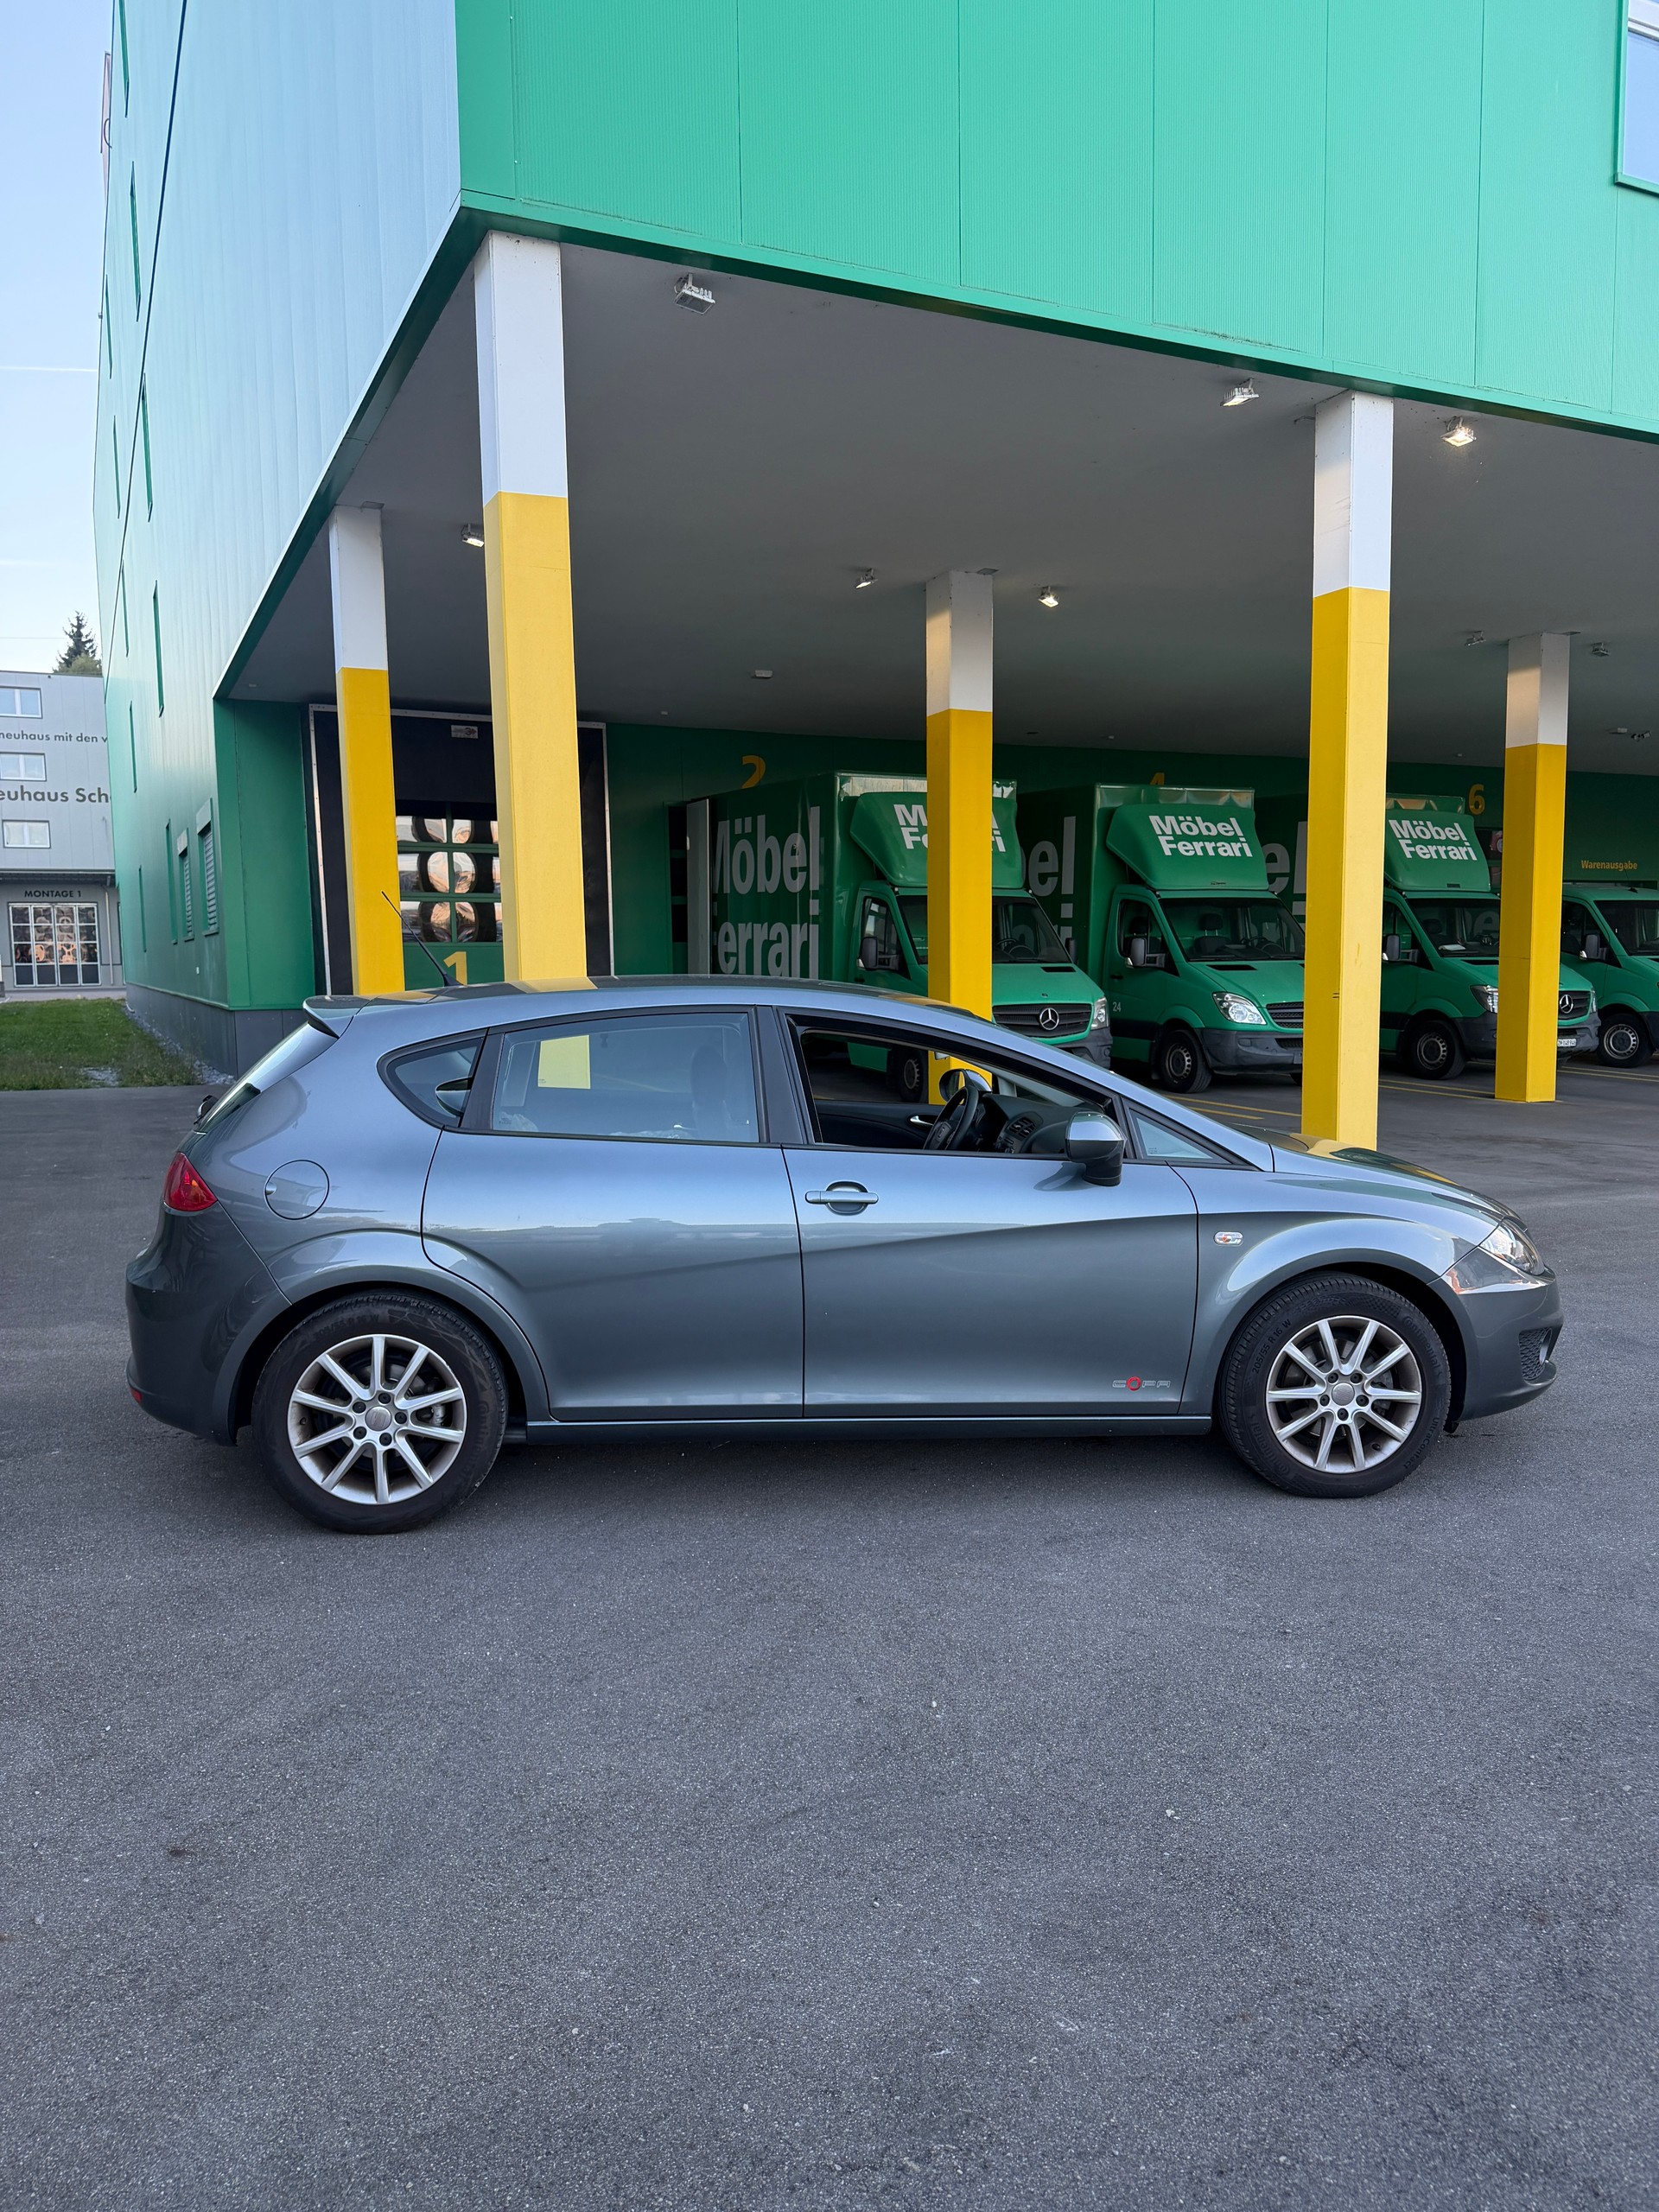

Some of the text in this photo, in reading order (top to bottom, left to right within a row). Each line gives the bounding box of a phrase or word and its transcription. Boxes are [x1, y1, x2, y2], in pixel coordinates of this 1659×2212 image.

[54, 732, 73, 742] mit
[76, 733, 98, 742] den
[741, 755, 766, 789] 2
[75, 787, 111, 803] Sch
[1468, 784, 1485, 815] 6
[1148, 815, 1244, 837] Möbel
[1388, 819, 1468, 842] Möbel
[1157, 836, 1253, 857] Ferrari
[1398, 839, 1478, 861] Ferrari
[1580, 860, 1638, 872] Warenausgabe
[713, 899, 819, 979] errari
[1112, 1001, 1122, 1012] 24
[1251, 1343, 1271, 1374] 205/55
[1273, 1327, 1283, 1337] 16
[1281, 1319, 1292, 1328] W
[1113, 1376, 1171, 1391] COPA
[1403, 1416, 1440, 1470] UltraContact
